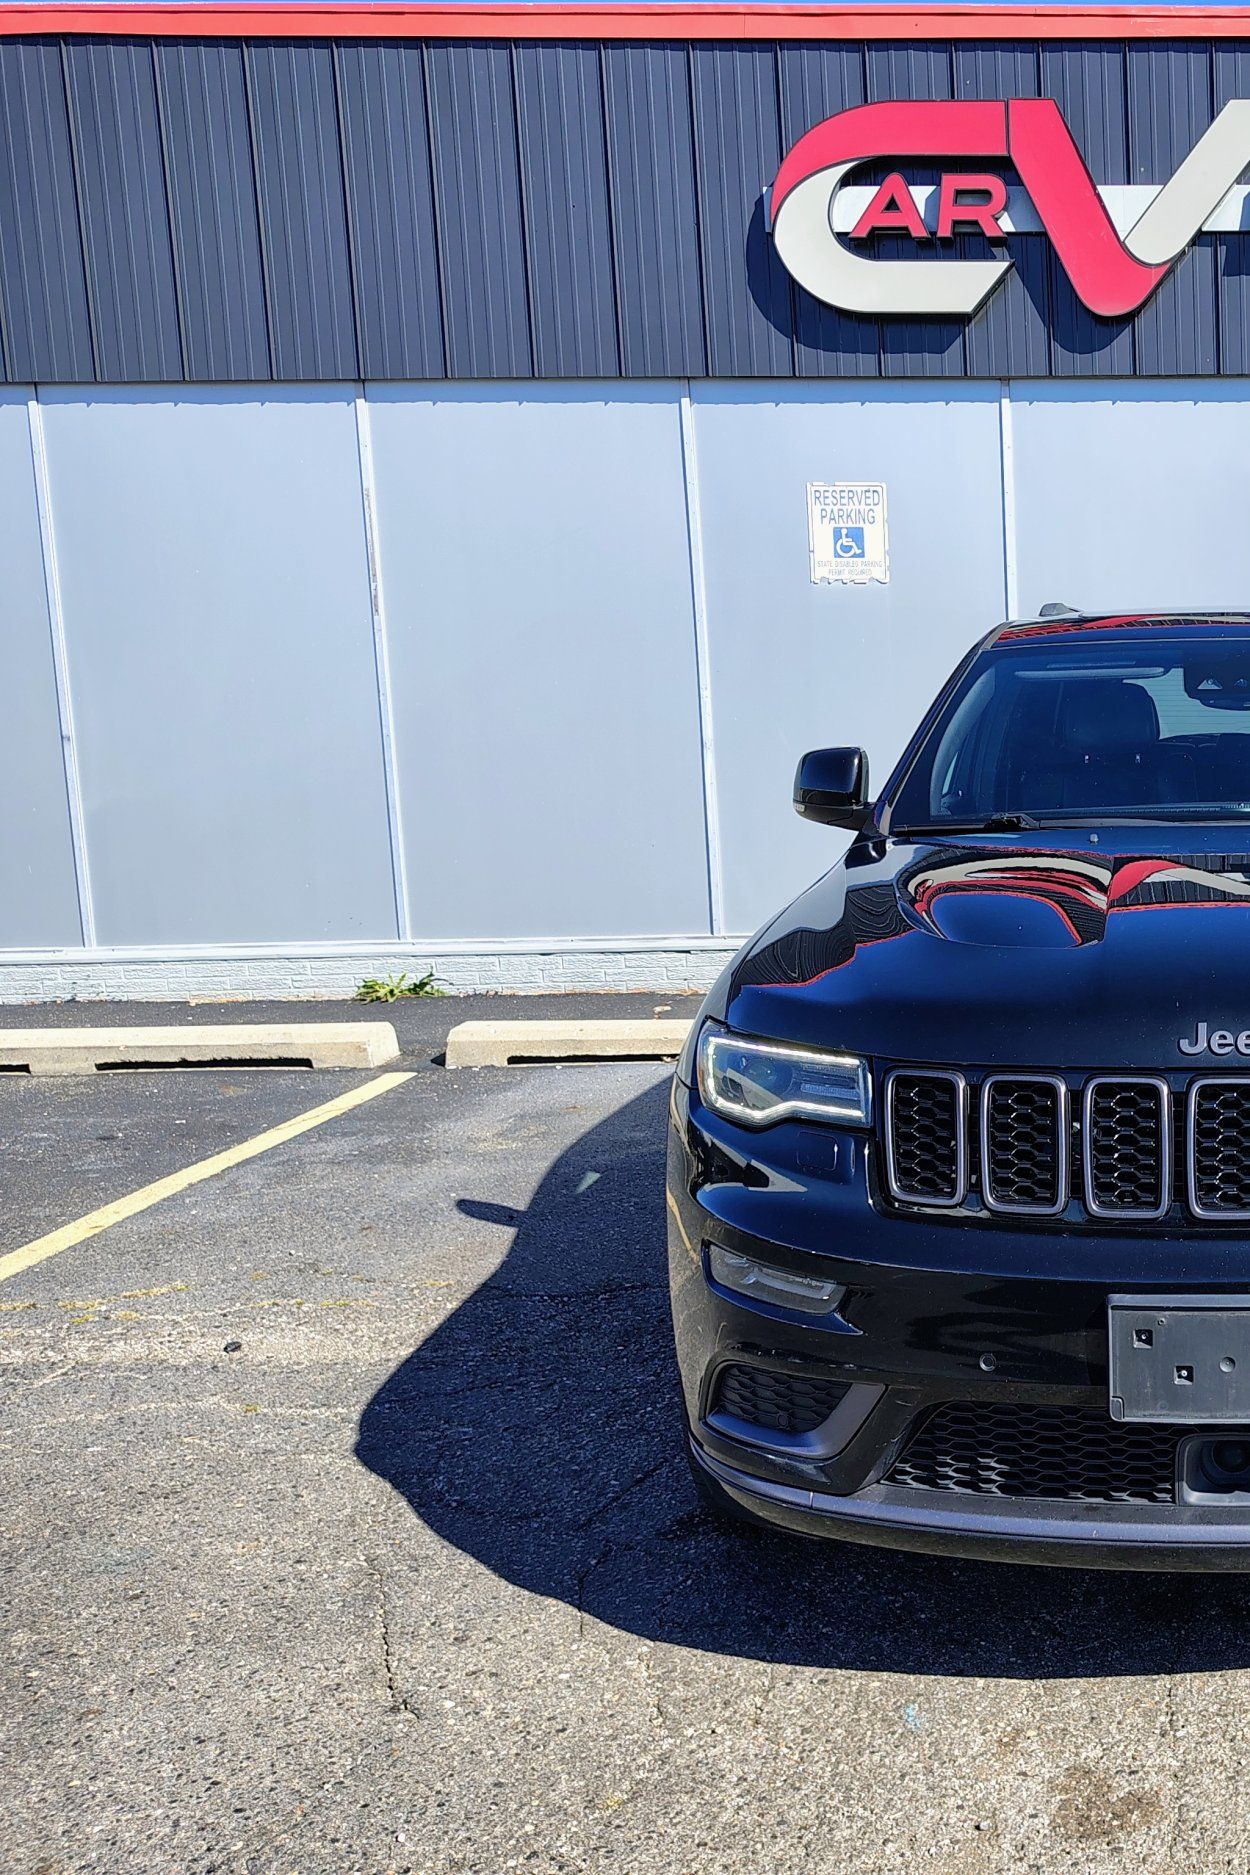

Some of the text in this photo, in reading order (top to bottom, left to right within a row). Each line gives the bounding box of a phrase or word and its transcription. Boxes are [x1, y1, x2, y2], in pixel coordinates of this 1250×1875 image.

[813, 489, 881, 506] RESERVED
[820, 508, 876, 524] PARKING
[817, 560, 833, 568] STATE
[860, 560, 883, 568] PARKING
